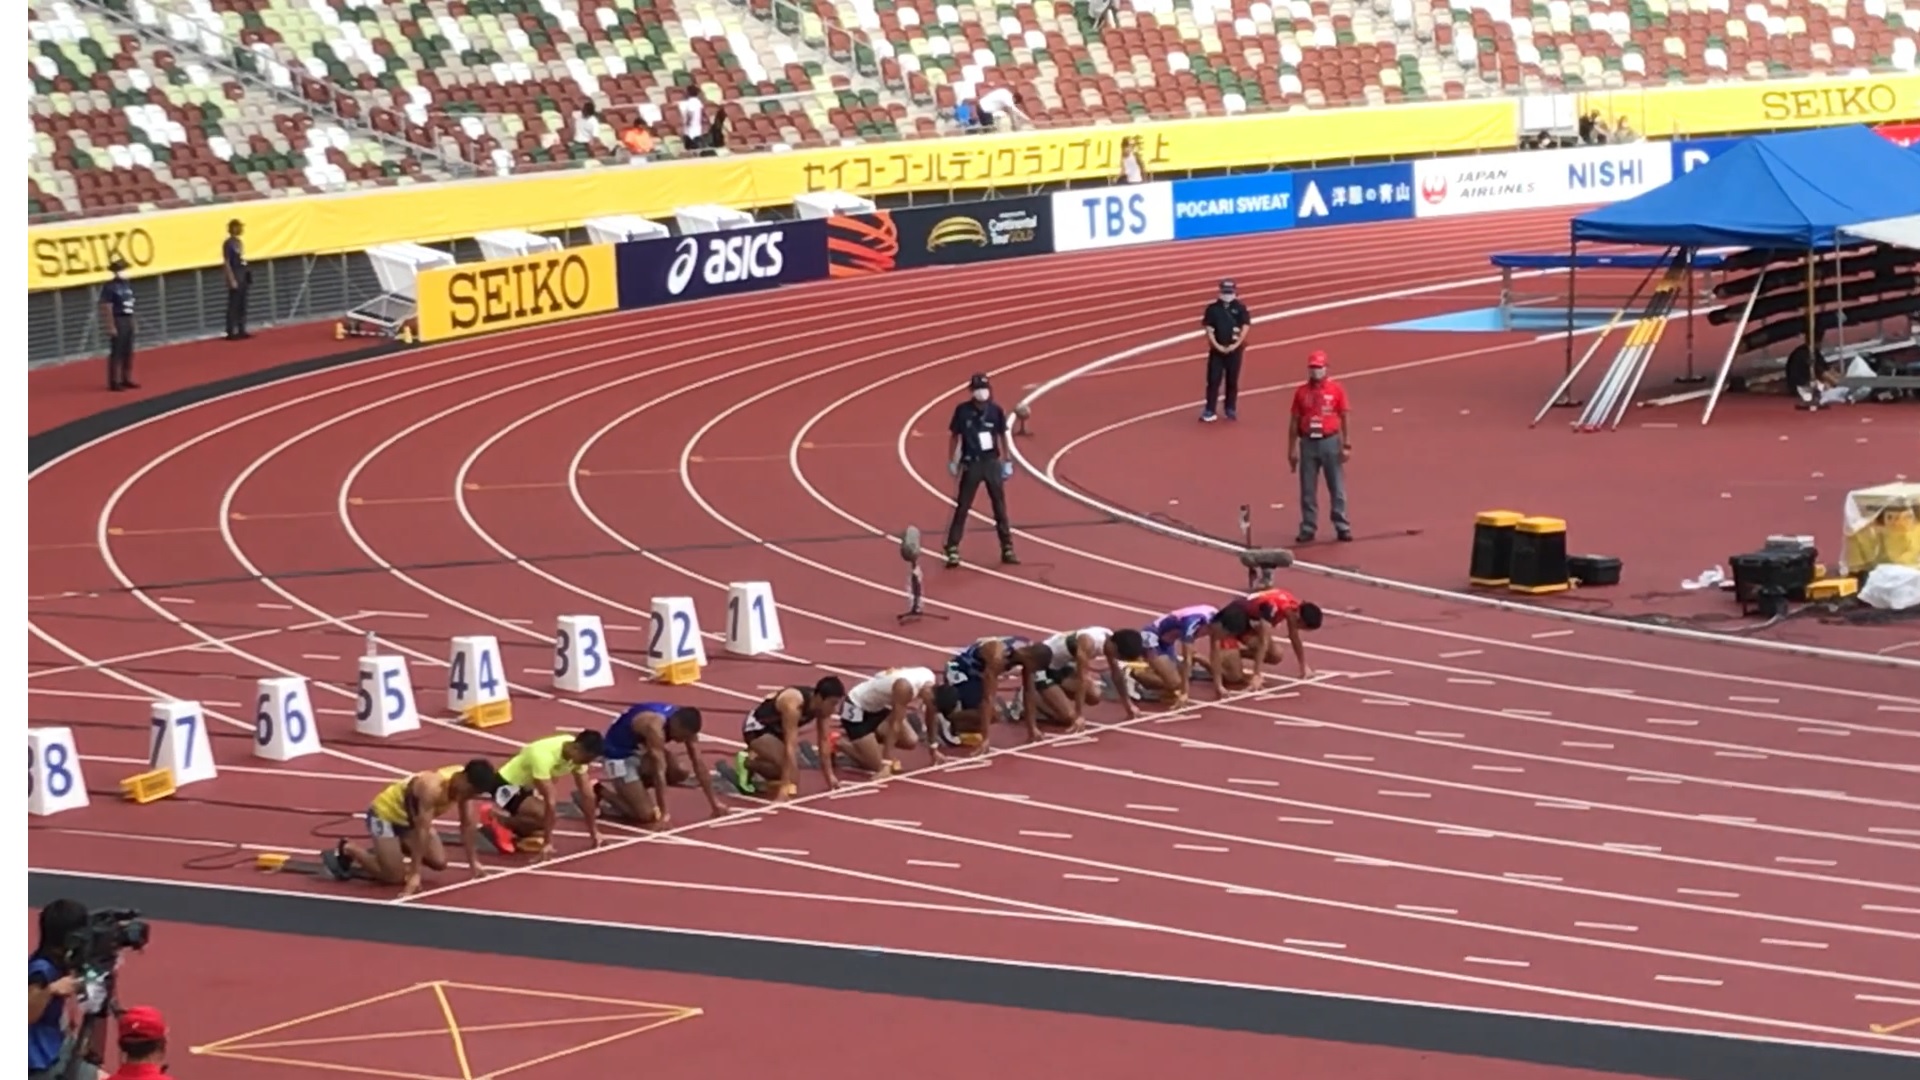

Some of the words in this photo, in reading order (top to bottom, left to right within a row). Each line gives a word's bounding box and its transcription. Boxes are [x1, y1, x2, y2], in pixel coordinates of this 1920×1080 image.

[1762, 84, 1896, 120] SEIKO
[1456, 169, 1508, 183] JAPAN
[1460, 182, 1535, 198] AIRLINES
[1568, 158, 1643, 189] NISHI
[1082, 193, 1146, 239] TBS
[1176, 199, 1234, 219] POCARI
[1237, 193, 1290, 213] SWEAT
[33, 228, 154, 277] SEIKO
[448, 254, 589, 329] SEIKO
[44, 743, 73, 797] 8
